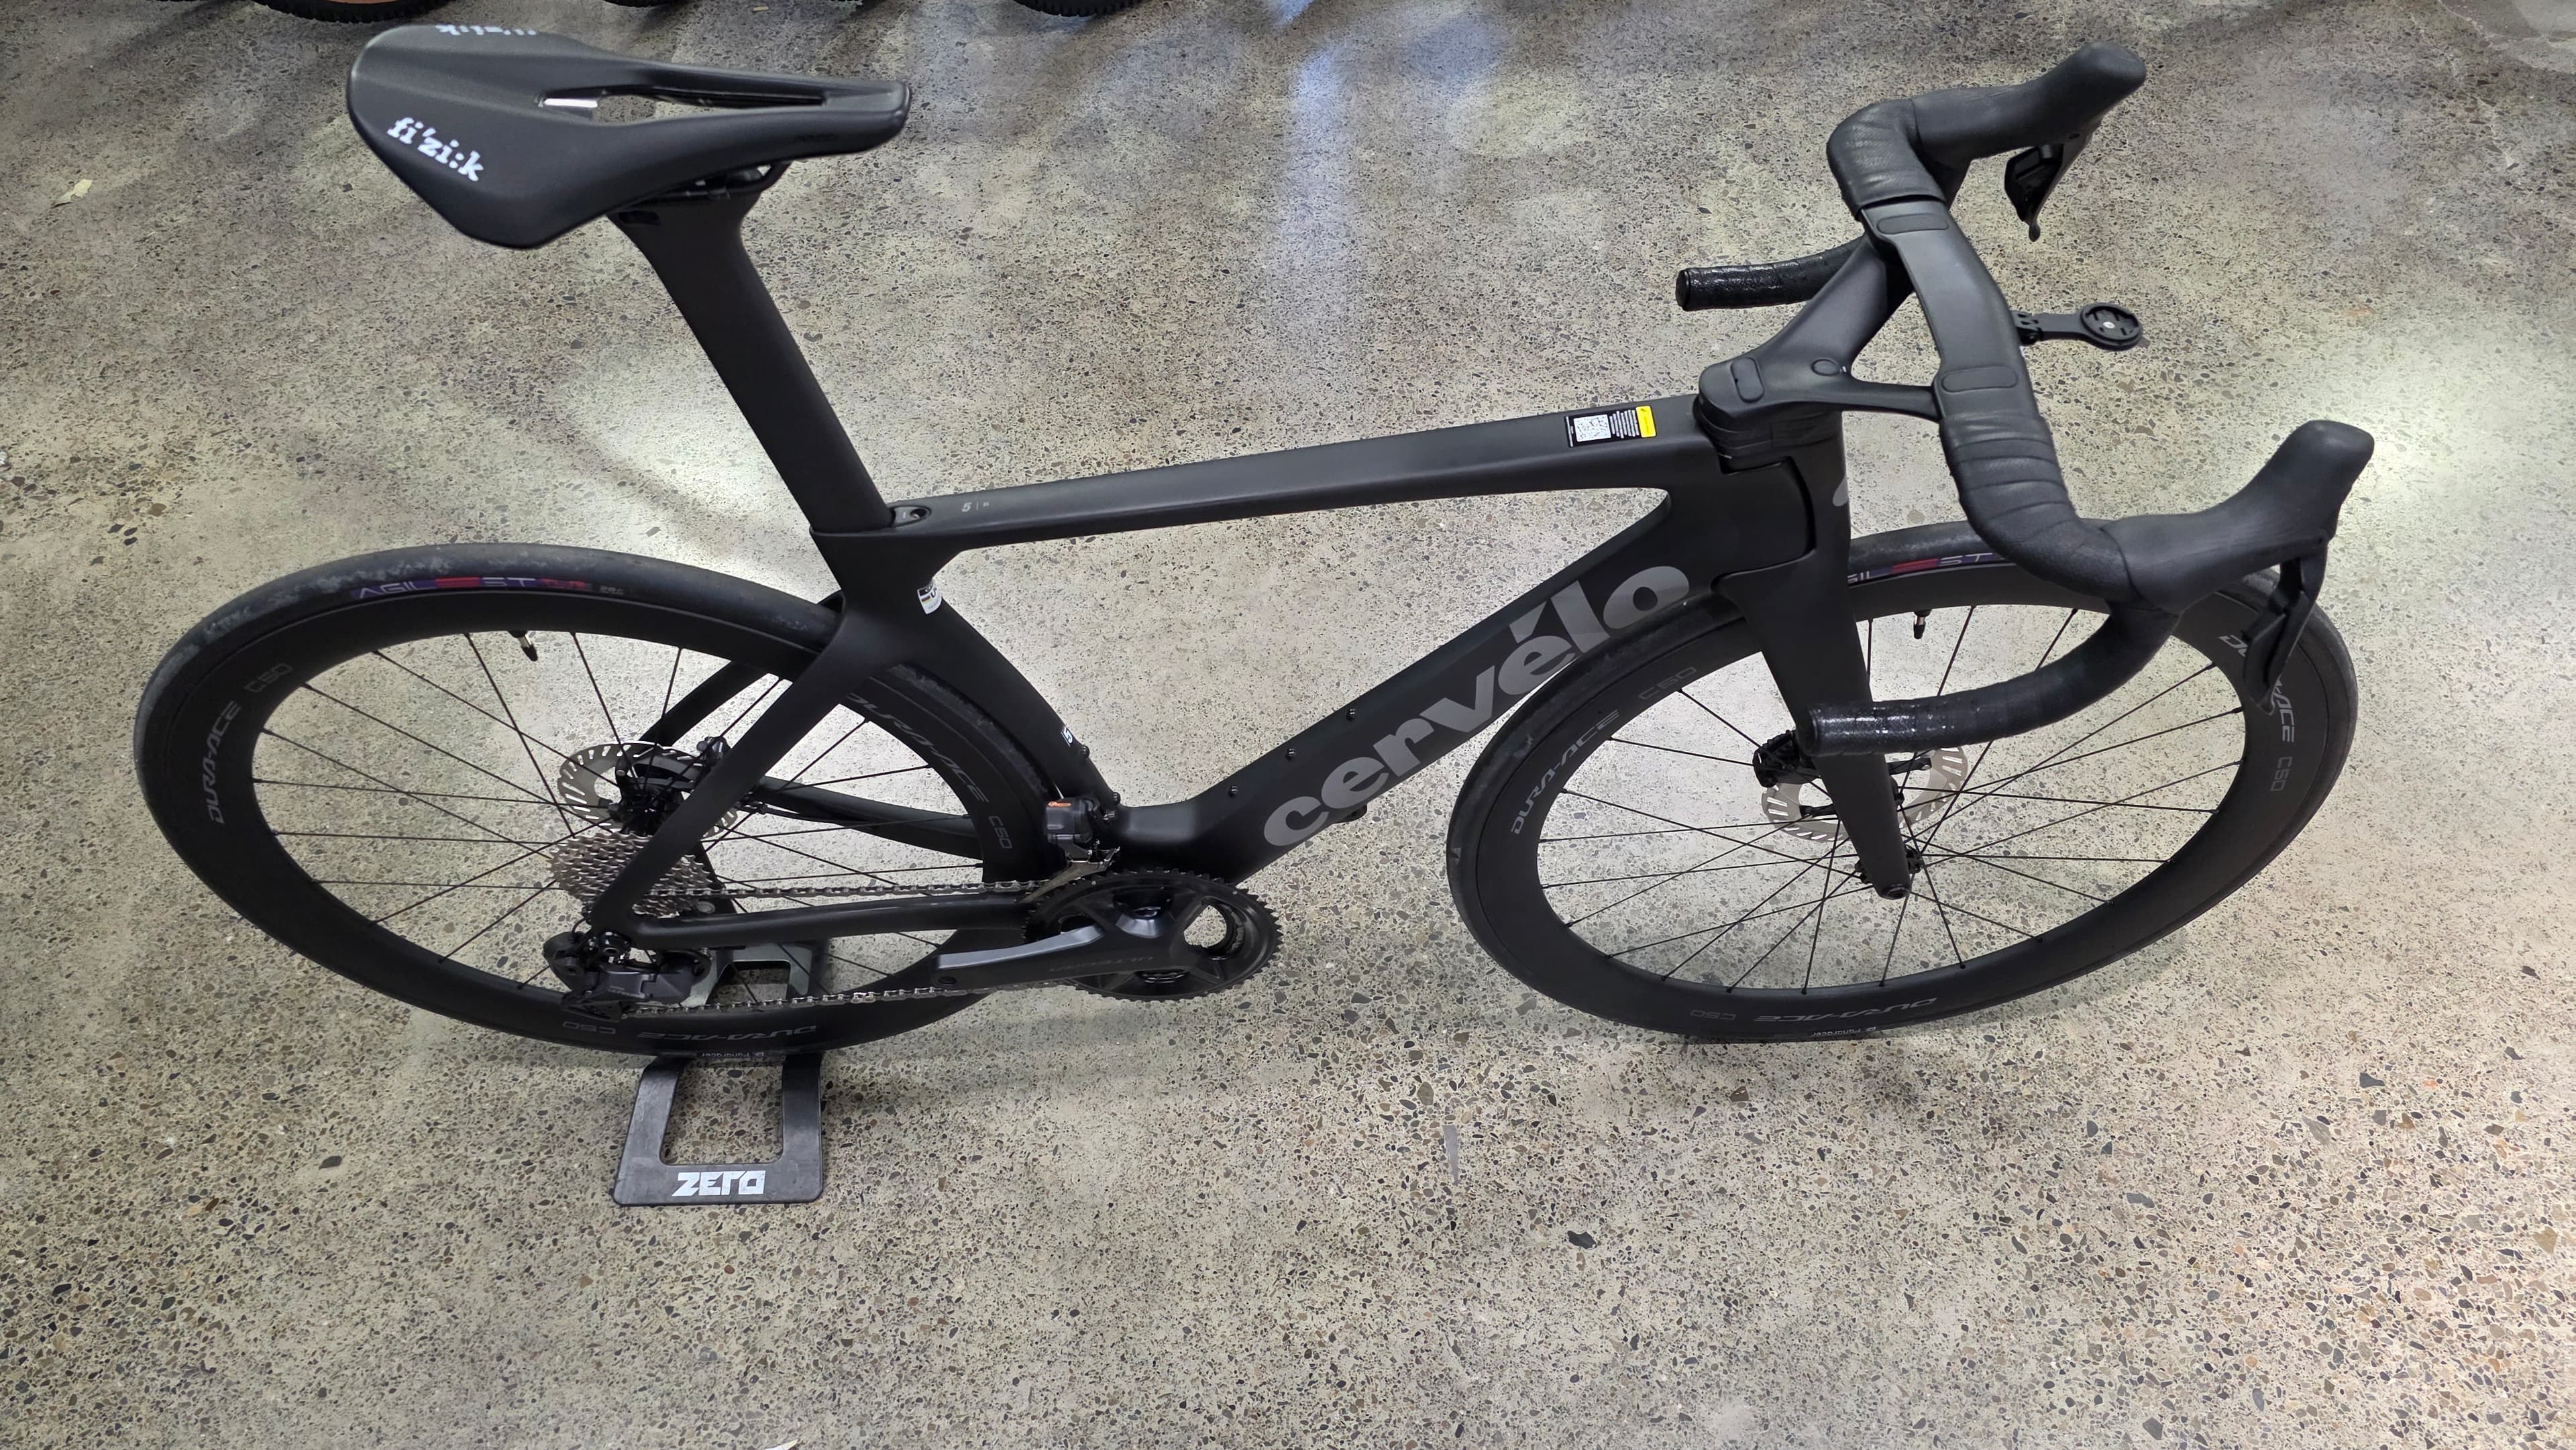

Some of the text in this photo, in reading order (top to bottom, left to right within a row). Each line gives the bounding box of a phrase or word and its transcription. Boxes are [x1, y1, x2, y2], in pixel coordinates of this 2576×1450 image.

[1264, 565, 1690, 846] cervélo
[202, 663, 294, 824] DURA-ACE C50
[1511, 709, 1619, 834] DURA-ACE
[989, 816, 1013, 848] C50
[1754, 997, 1938, 1021] DURA-ACE
[637, 1025, 816, 1041] DURA-ACE
[672, 1170, 765, 1196] ZERO
